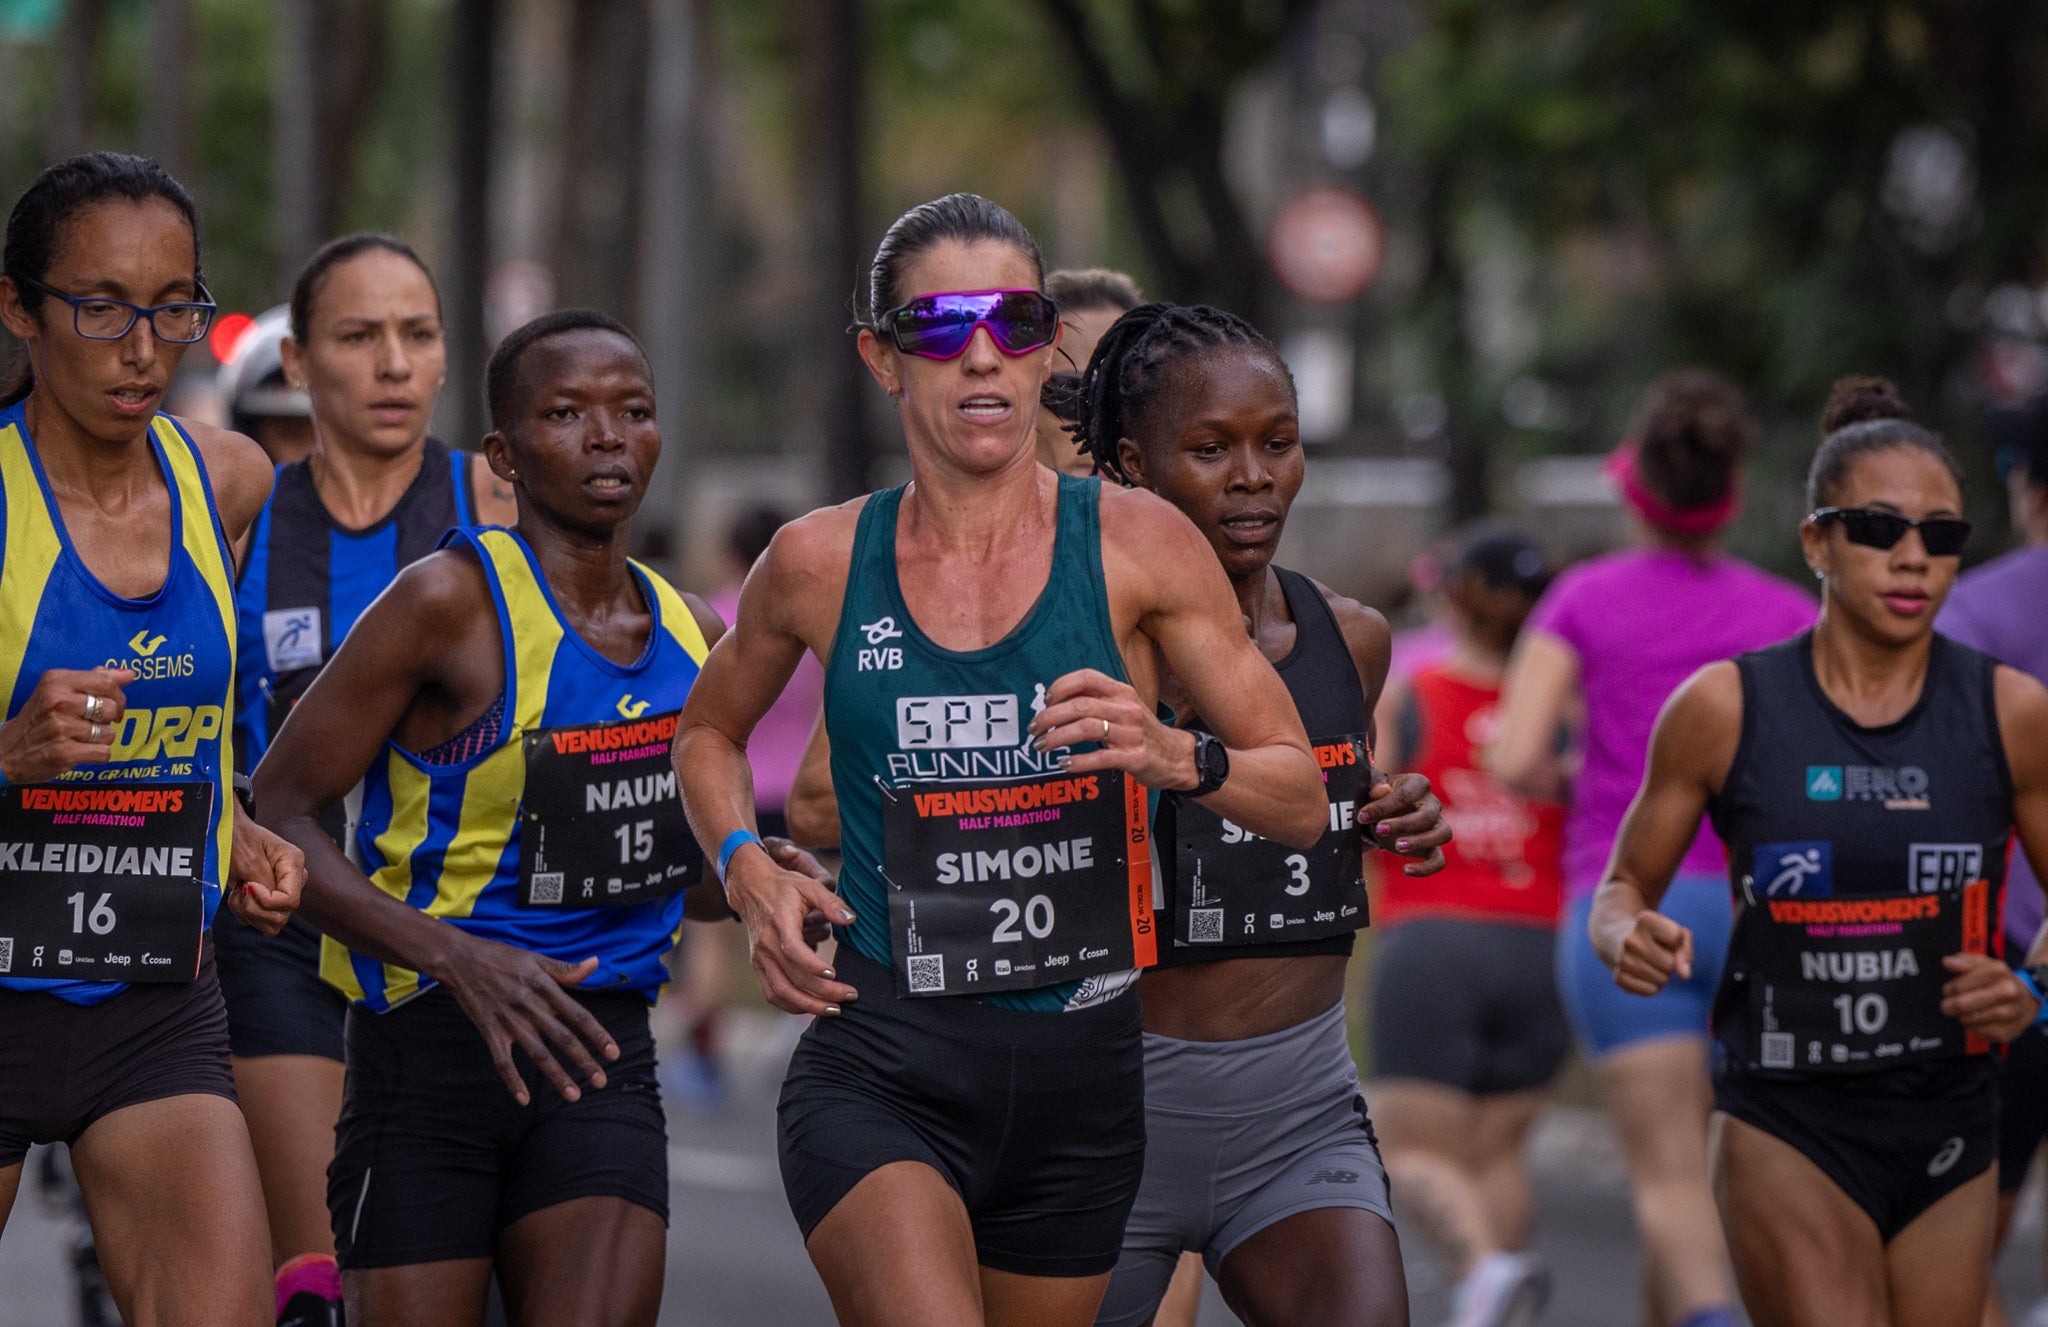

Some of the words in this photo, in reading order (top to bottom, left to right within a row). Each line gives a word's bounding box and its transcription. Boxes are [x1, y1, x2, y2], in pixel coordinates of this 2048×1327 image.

[858, 648, 904, 672] RVB
[905, 699, 1009, 744] SPF
[591, 751, 618, 765] HALF
[619, 743, 669, 762] MARATHON
[887, 745, 1071, 777] RUNNING
[56, 769, 94, 782] MPO
[98, 765, 162, 780] GRANDE
[170, 763, 193, 776] MS
[21, 788, 184, 813] VENUSWOMEN'S
[586, 770, 677, 813] NAUM
[914, 775, 1100, 818] VENUSWOMEN'S
[53, 813, 81, 825] HALF
[82, 814, 146, 827] MARATHON
[959, 814, 992, 831] HALF
[993, 808, 1061, 828] MARATHON
[1131, 826, 1145, 843] 20
[614, 819, 655, 864] 15
[0, 842, 194, 877] KLEIDIANE
[935, 836, 1095, 885] SIMONE
[1283, 853, 1311, 896] 3
[67, 891, 117, 935] 16
[989, 893, 1056, 944] 20
[1136, 916, 1152, 935] 20
[1313, 910, 1336, 923] Jeep
[104, 952, 132, 967] Jeep
[1043, 955, 1070, 968] Jeep
[1800, 947, 1920, 983] NUBIA
[1833, 992, 1889, 1035] 10
